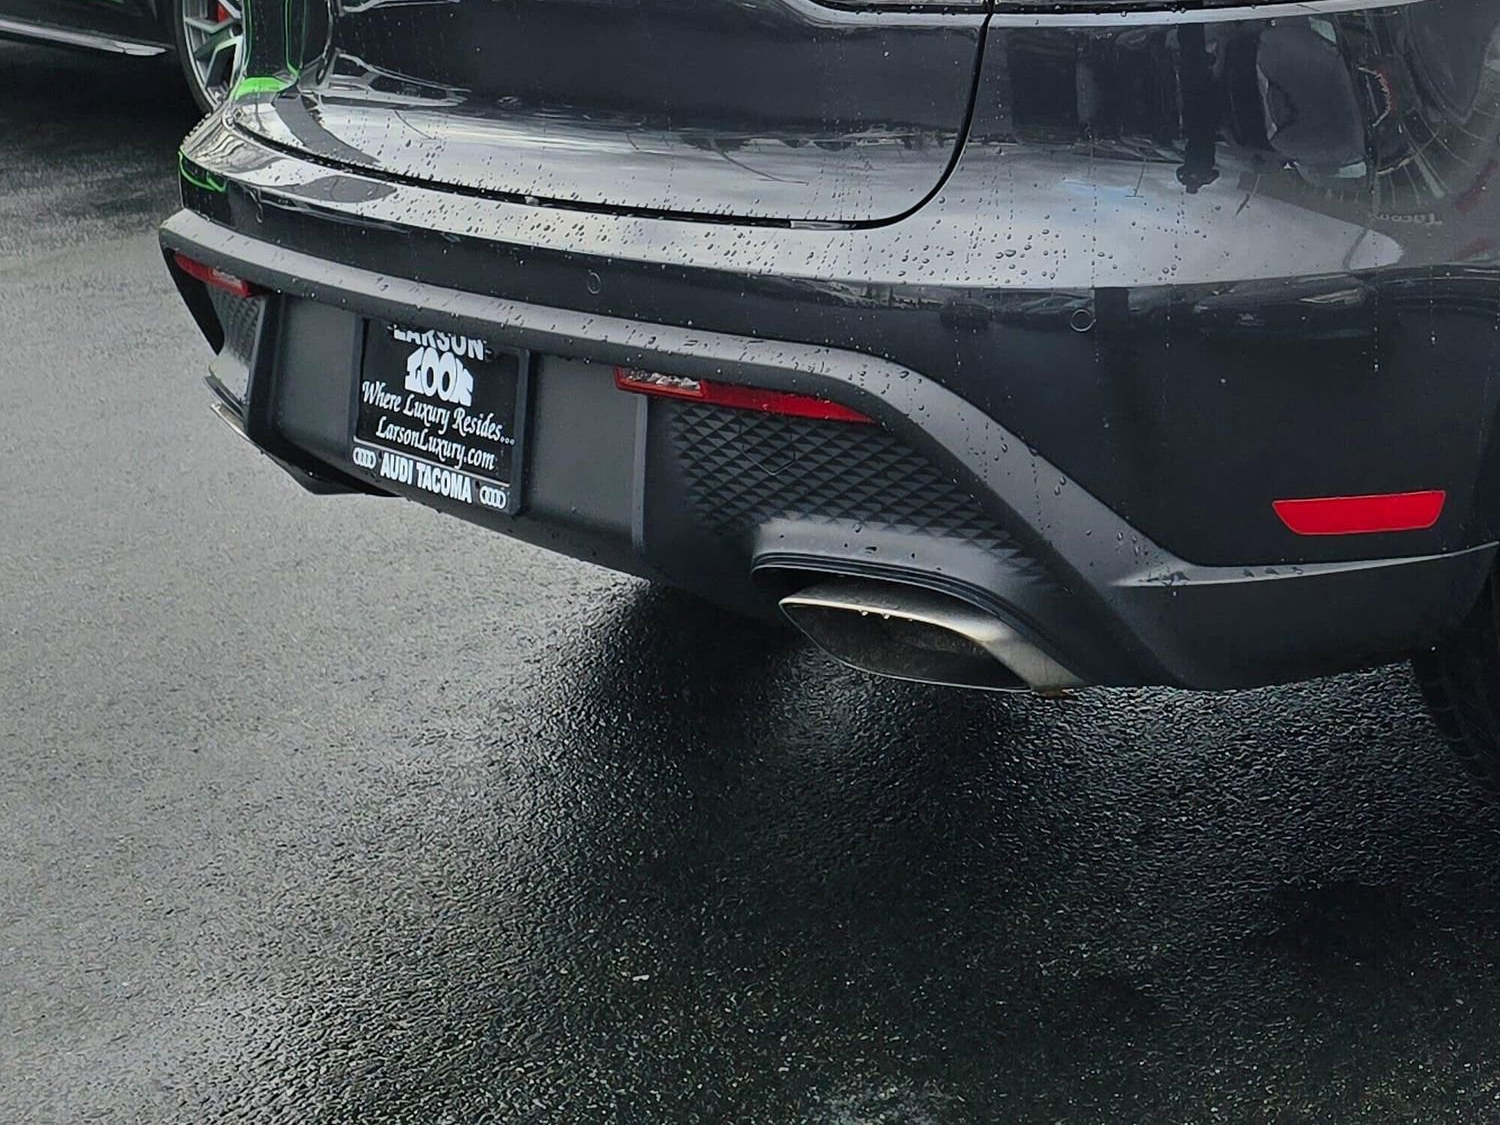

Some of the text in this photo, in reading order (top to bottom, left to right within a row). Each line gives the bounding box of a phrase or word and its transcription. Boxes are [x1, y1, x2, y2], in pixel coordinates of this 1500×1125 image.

[362, 381, 515, 445] Where Luxury Resides...
[376, 416, 496, 470] LarsonLuxury.com
[380, 453, 473, 504] AUDI TACOMA
